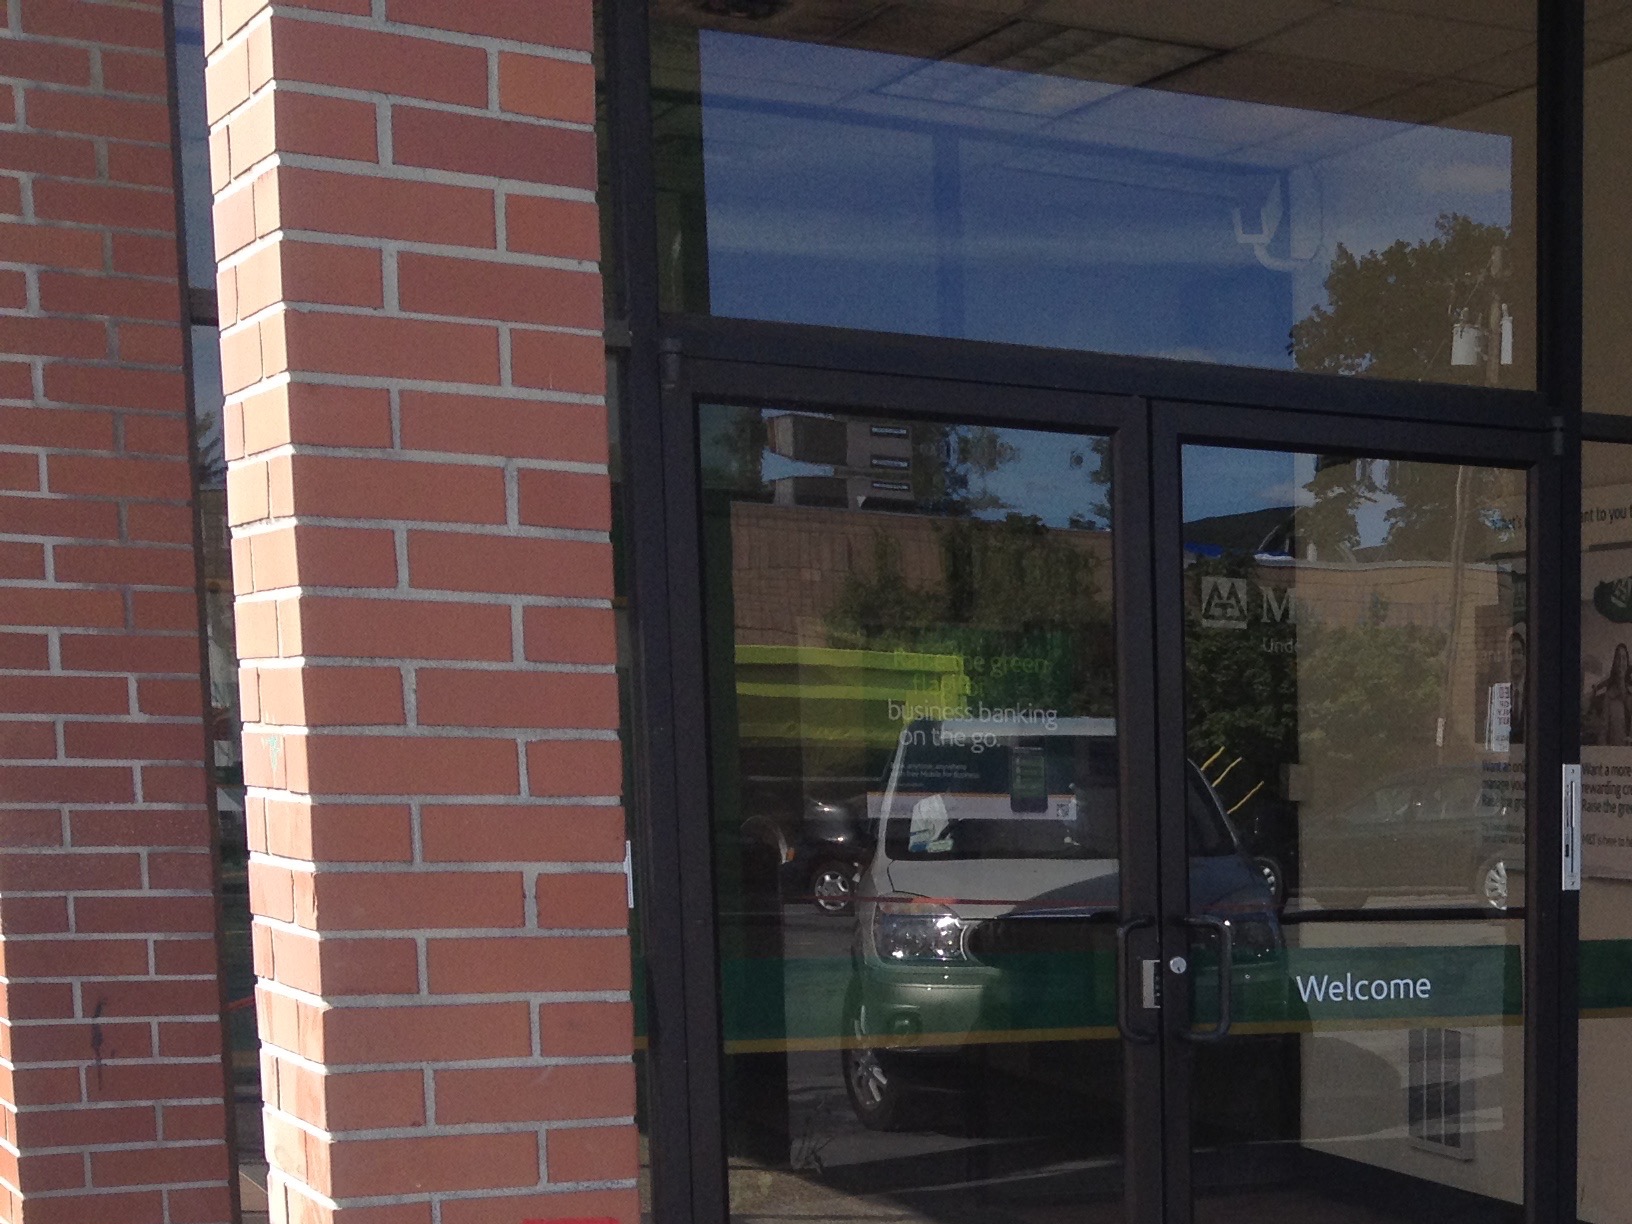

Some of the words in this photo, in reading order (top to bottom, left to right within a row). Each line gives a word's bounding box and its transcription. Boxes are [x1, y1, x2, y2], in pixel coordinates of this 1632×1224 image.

[1608, 507, 1627, 525] you
[887, 697, 974, 723] business
[978, 700, 1058, 731] banking
[899, 728, 926, 746] on
[931, 727, 966, 747] the
[970, 730, 1001, 753] go.
[1582, 762, 1603, 777] Want
[1604, 766, 1610, 777] a
[1610, 766, 1632, 777] more
[1582, 780, 1621, 800] rewarding
[1582, 798, 1602, 813] Raise
[1602, 799, 1617, 814] the
[1295, 972, 1432, 1003] Welcome
